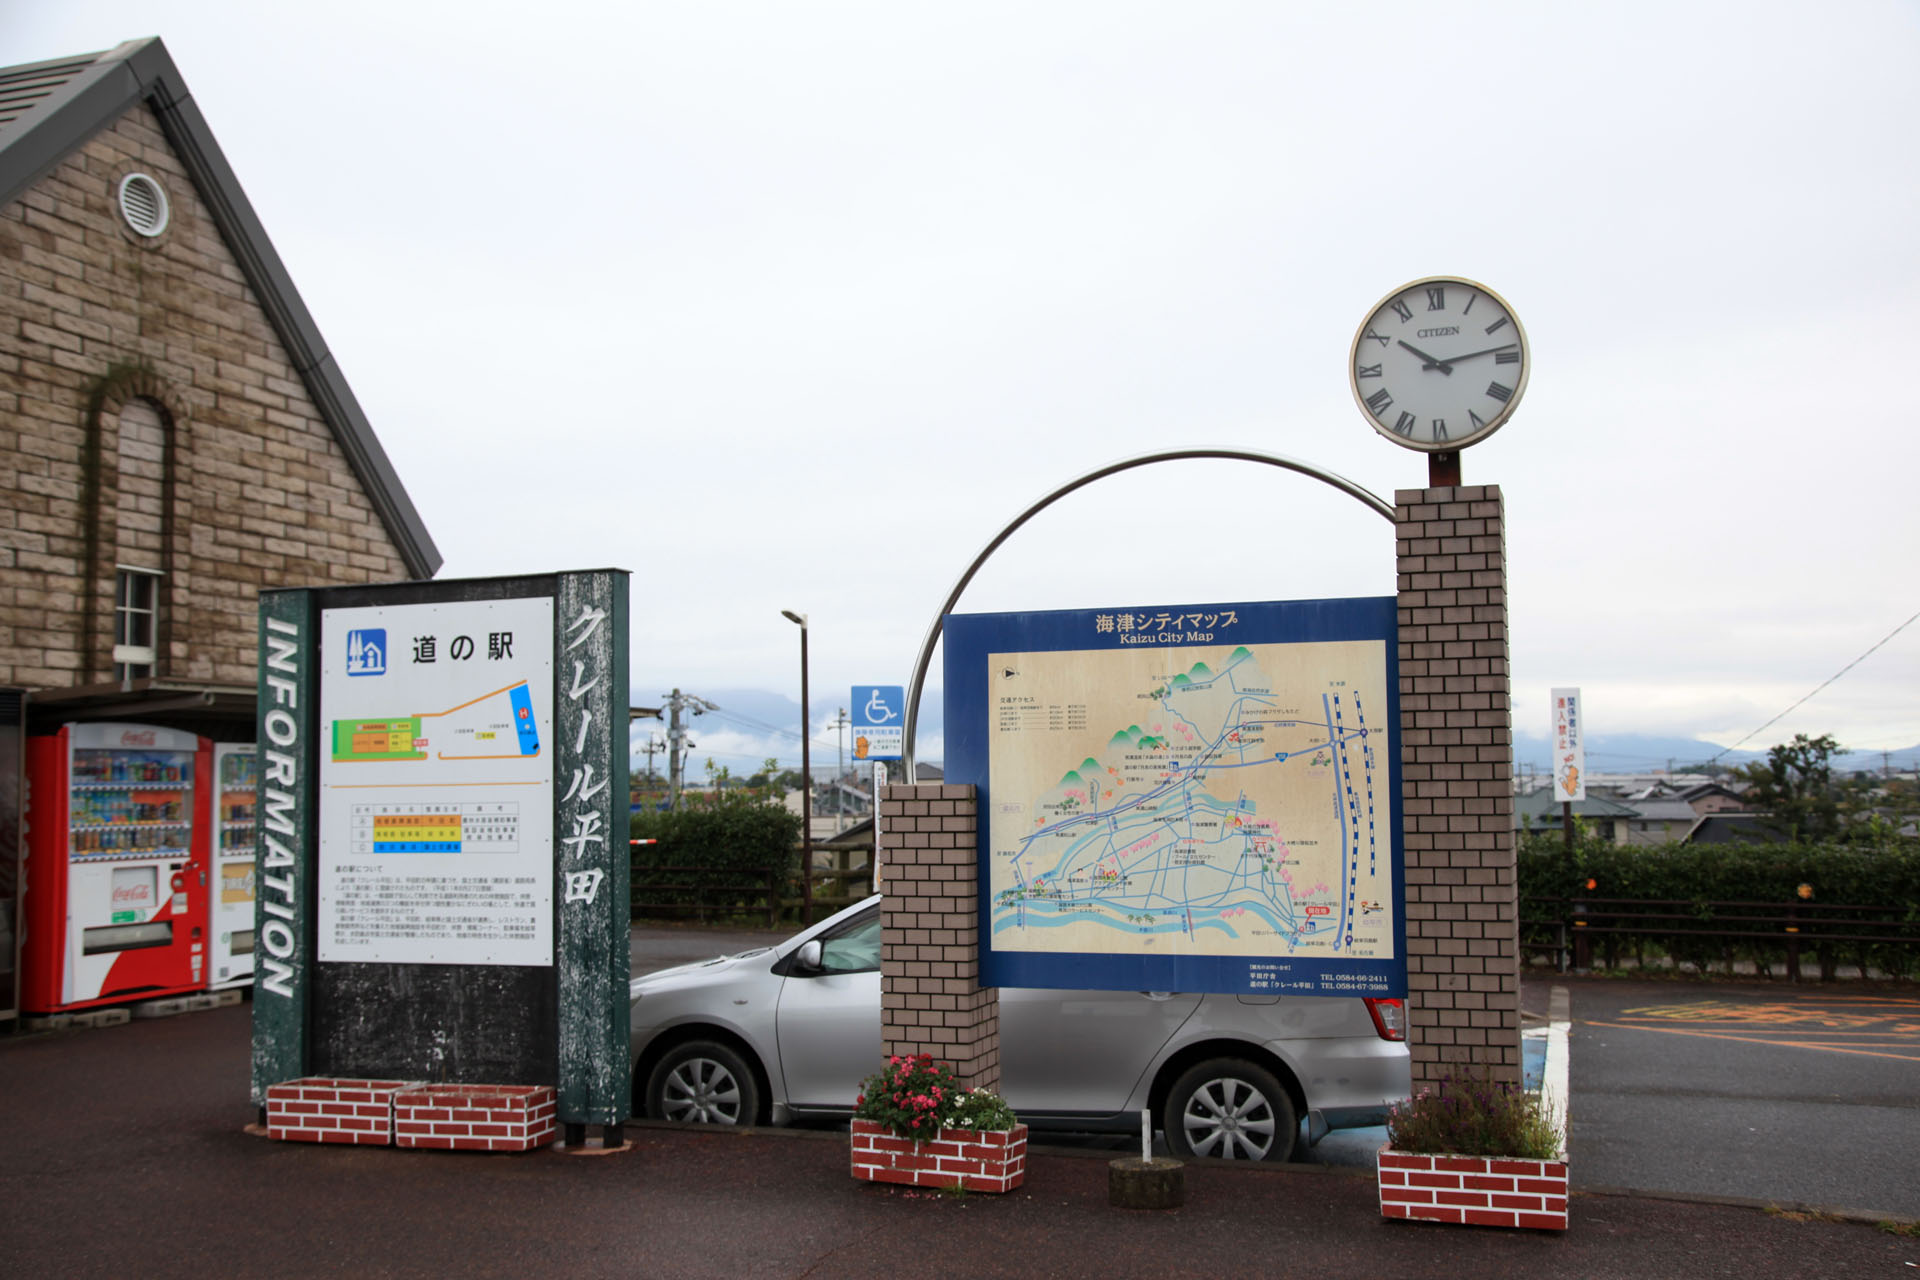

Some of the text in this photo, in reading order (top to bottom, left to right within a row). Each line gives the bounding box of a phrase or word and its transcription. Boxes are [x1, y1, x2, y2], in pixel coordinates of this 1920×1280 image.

[1417, 326, 1460, 338] CITIZEN
[1096, 610, 1238, 633] 海津シティマップ
[412, 631, 514, 664] 道の駅
[1120, 631, 1214, 644] Kaizu City Map
[1557, 697, 1567, 749] 進入禁止
[561, 604, 610, 905] クレール平田
[262, 616, 298, 998] INFORMATION
[1250, 981, 1315, 989] 道の駅「クレール平田」
[1320, 982, 1335, 990] TEL
